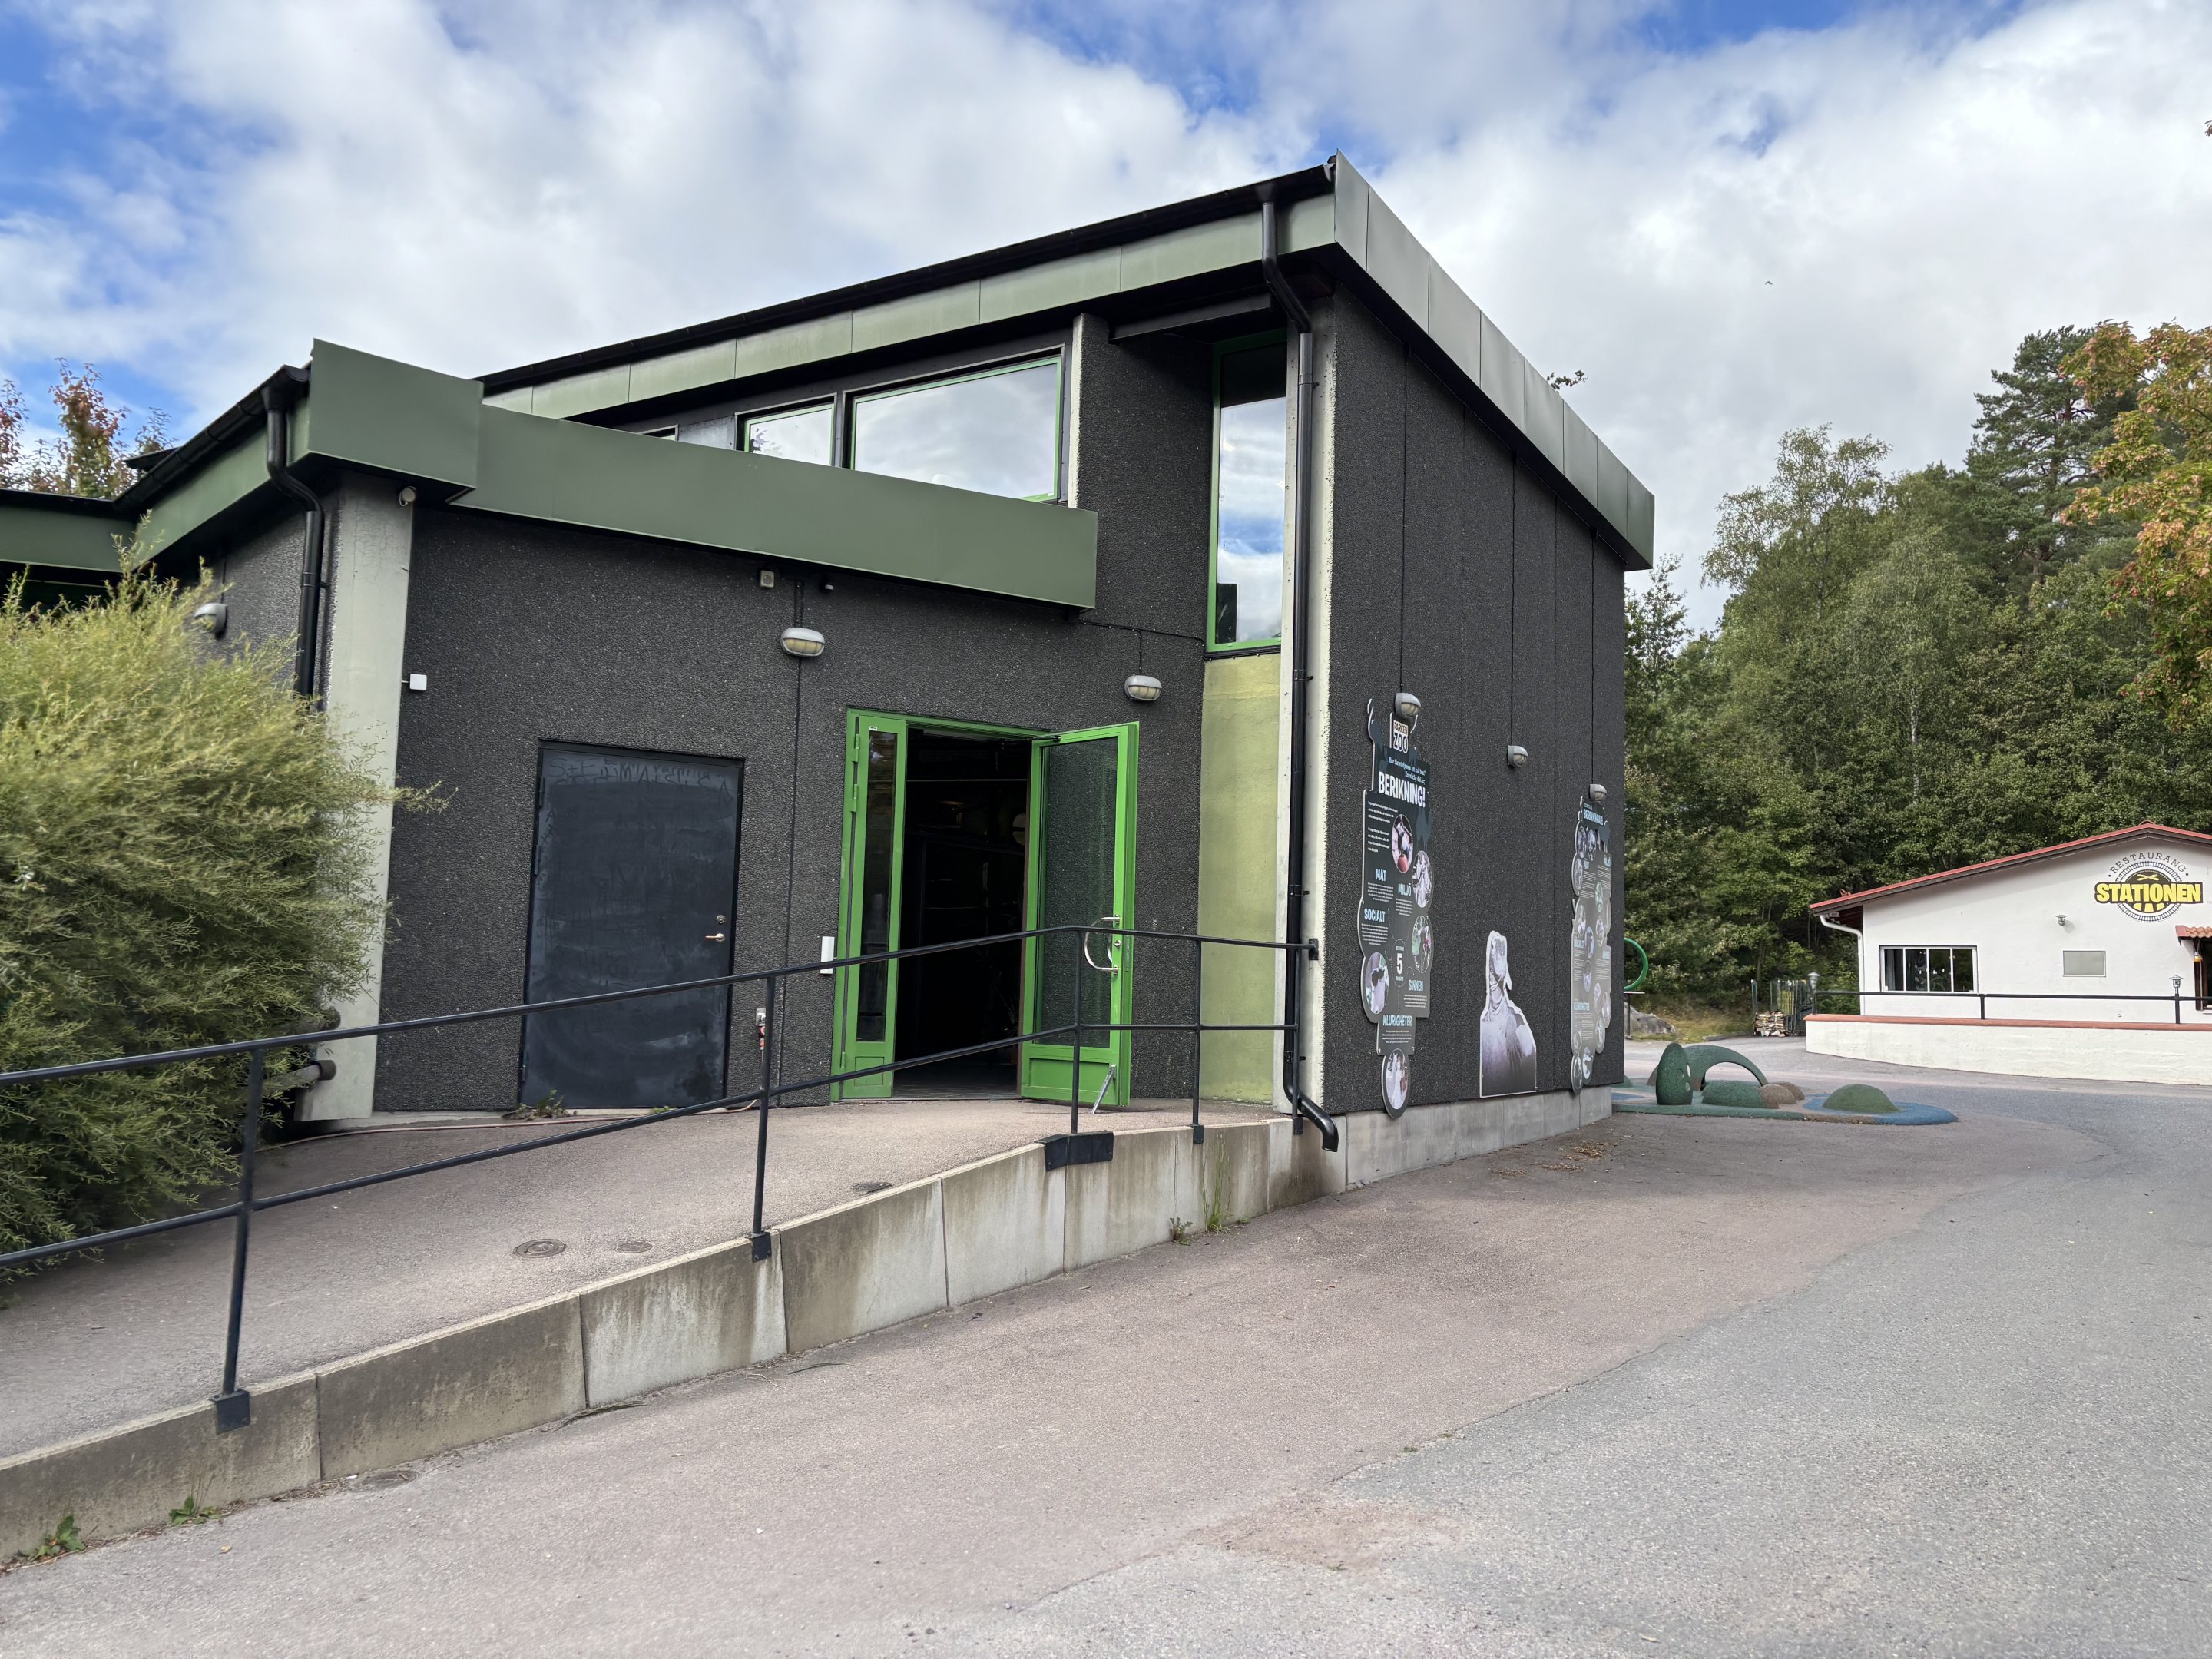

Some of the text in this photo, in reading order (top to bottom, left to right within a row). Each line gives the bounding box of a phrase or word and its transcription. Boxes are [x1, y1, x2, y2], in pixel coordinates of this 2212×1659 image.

[1393, 732, 1408, 753] ZOO
[1379, 771, 1426, 808] BERIKNING!
[2110, 852, 2187, 873] RESTAURANG
[1376, 869, 1387, 882] MAT
[1398, 882, 1412, 897] MILJÖ
[2096, 883, 2201, 902] STATIONEN
[1364, 908, 1386, 922] SOCIALT
[1396, 953, 1403, 975] 5
[1382, 1015, 1412, 1027] KLURIGHETER
